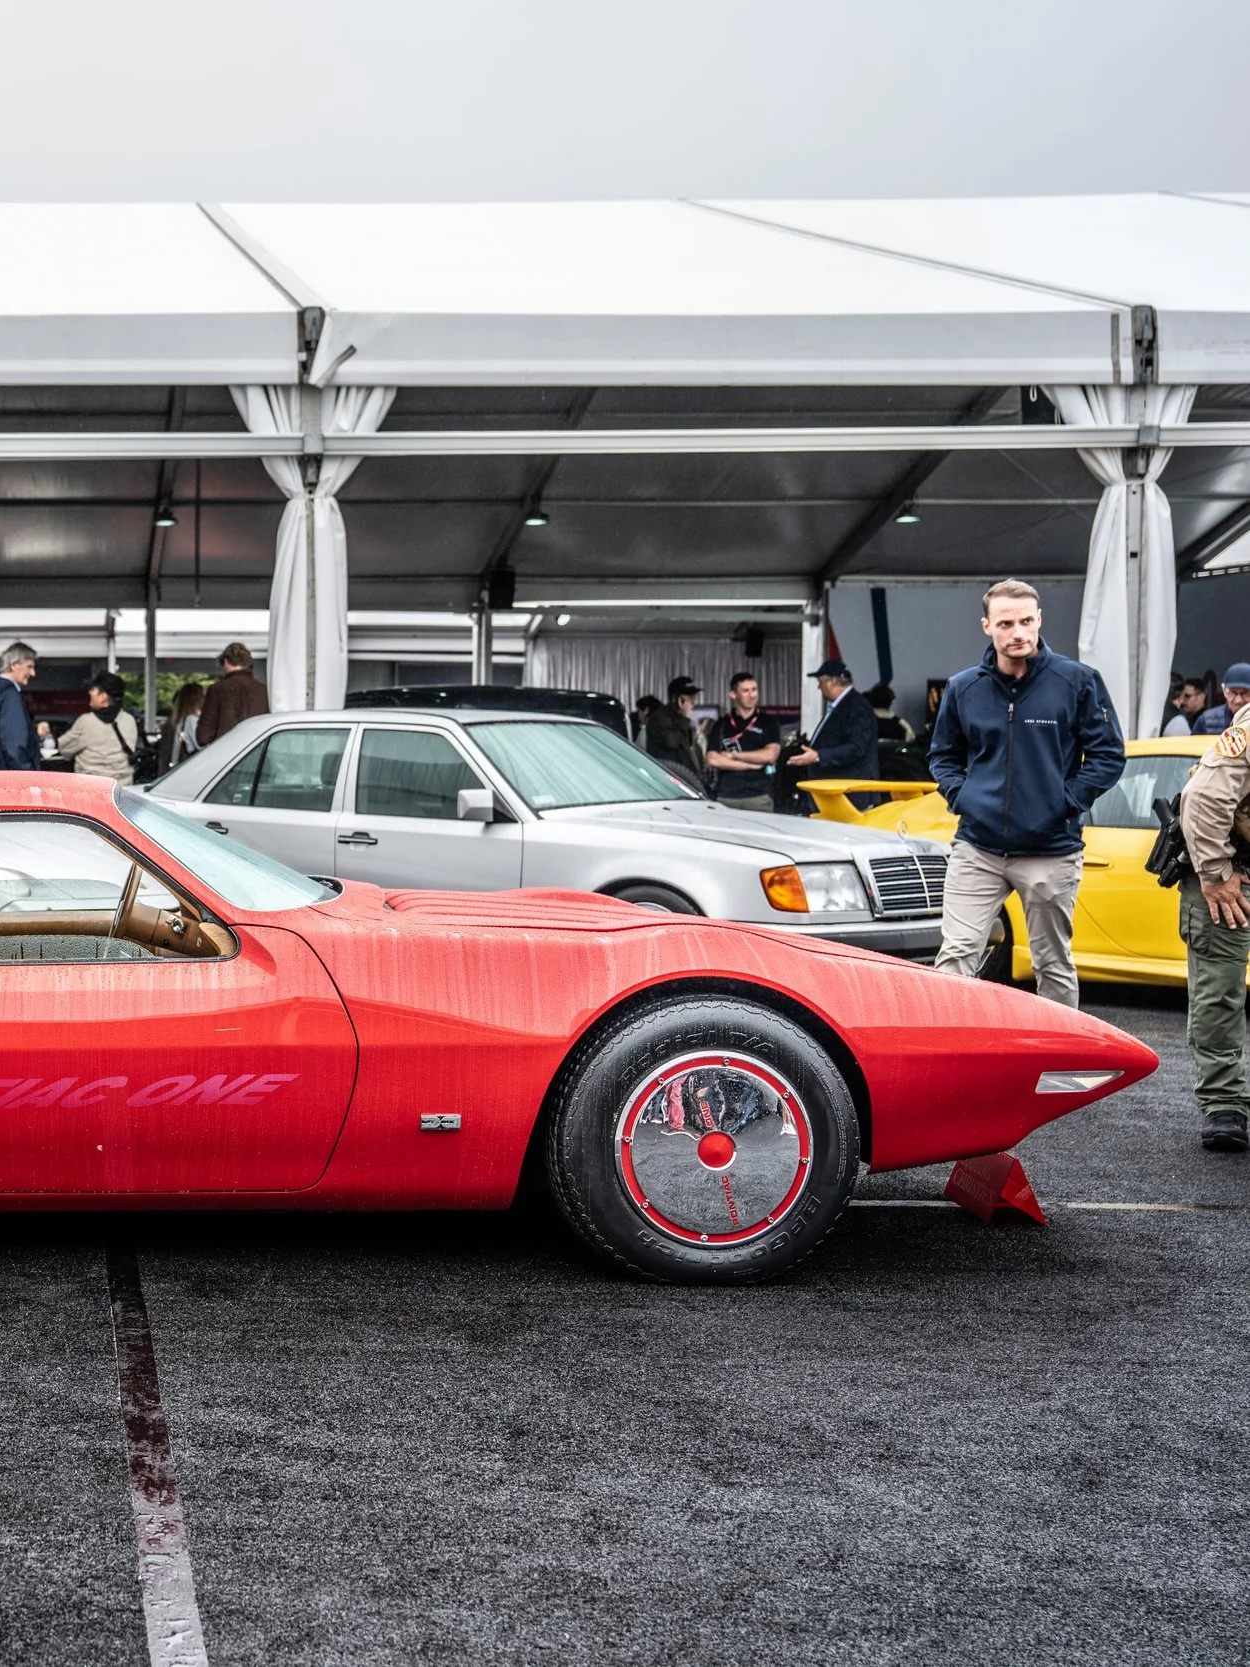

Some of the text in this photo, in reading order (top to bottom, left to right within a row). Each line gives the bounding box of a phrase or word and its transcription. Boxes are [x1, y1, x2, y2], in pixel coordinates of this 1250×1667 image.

[127, 1073, 301, 1107] ONE
[699, 1101, 740, 1226] PONTIAC ONE
